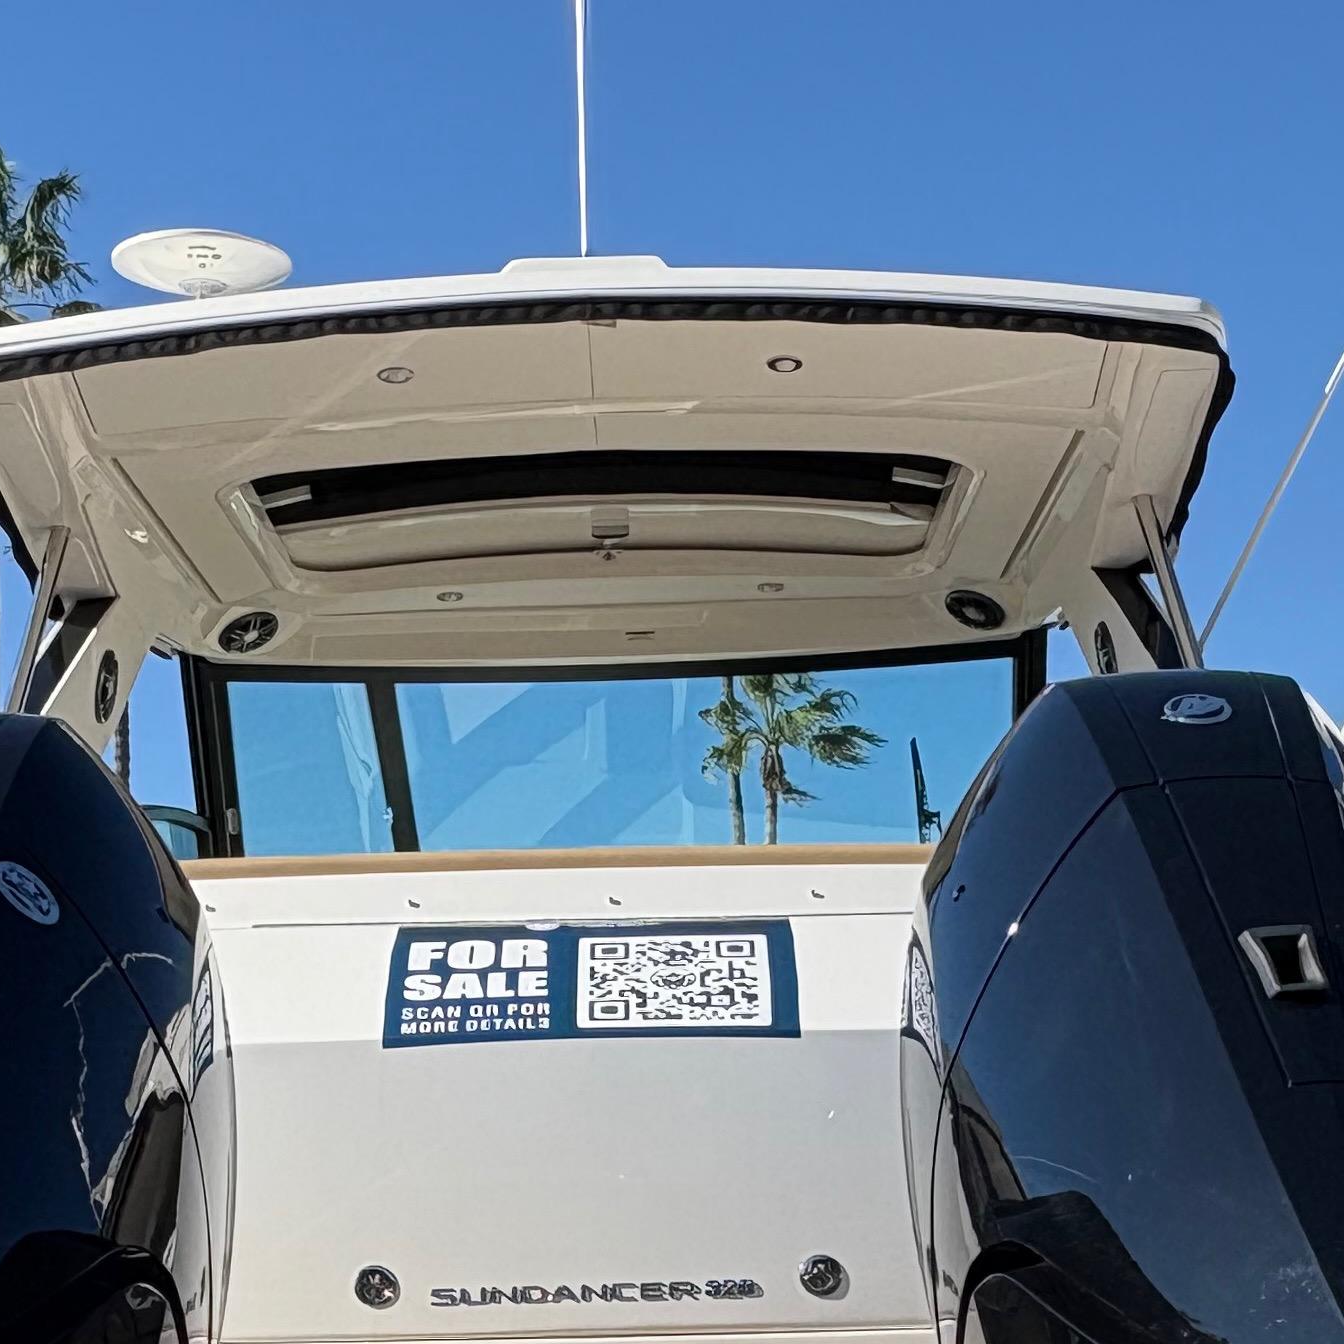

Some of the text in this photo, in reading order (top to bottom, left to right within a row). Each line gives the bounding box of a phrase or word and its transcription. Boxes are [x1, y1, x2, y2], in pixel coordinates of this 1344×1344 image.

[407, 939, 549, 971] FOR
[402, 970, 549, 1002] SALE
[401, 1005, 461, 1020] SCAN
[507, 1002, 550, 1016] FOR
[400, 1017, 550, 1035] MORE DETAILS
[430, 1281, 702, 1307] SUNDANCER
